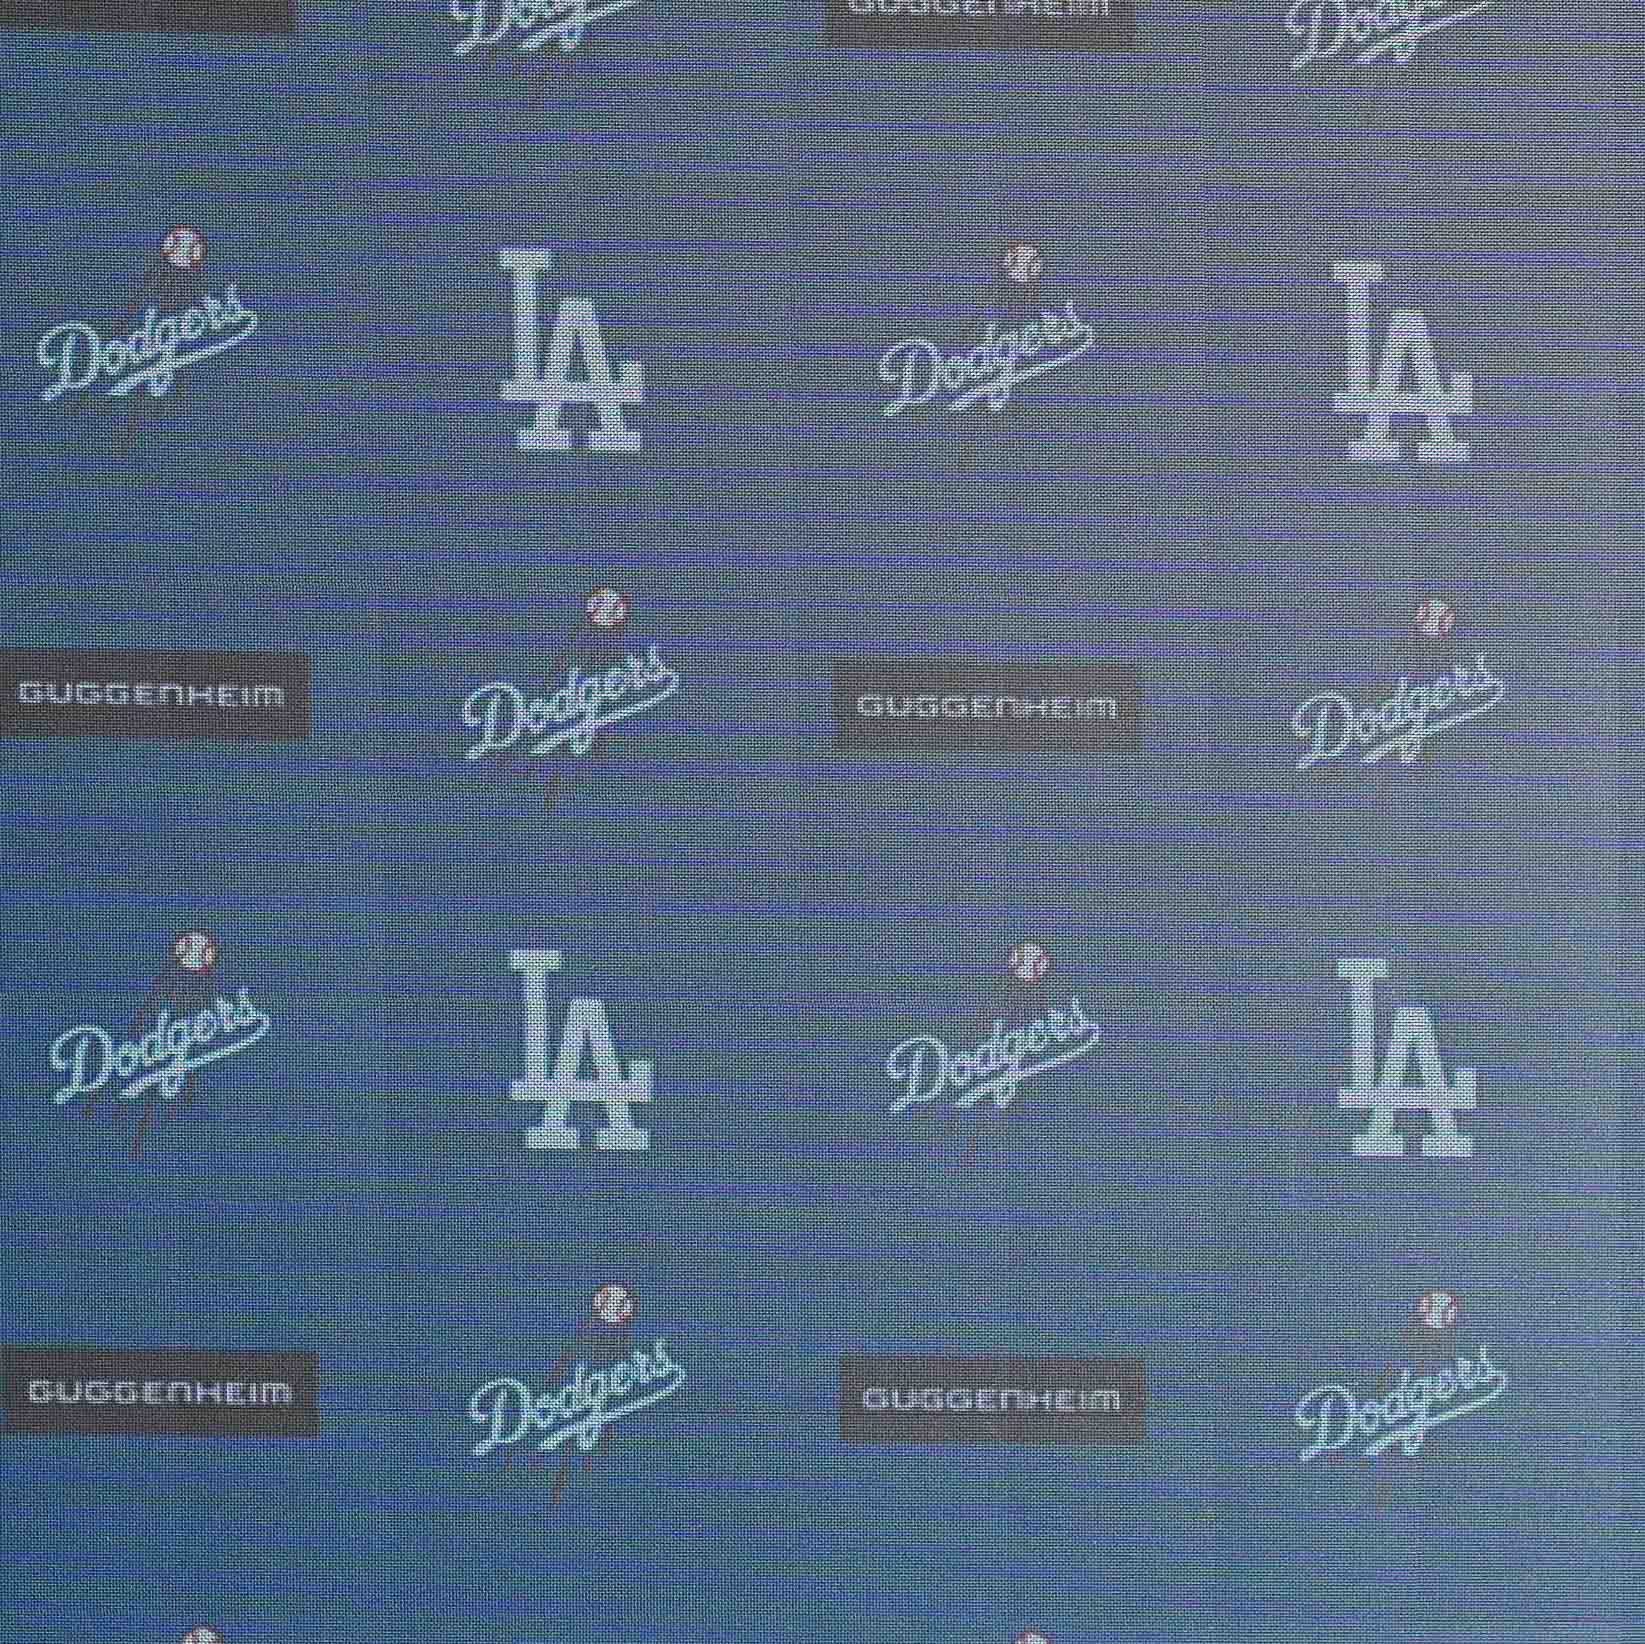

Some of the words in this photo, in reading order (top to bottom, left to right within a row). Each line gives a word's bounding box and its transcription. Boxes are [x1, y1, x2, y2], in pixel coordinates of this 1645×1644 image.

[36, 283, 258, 402] Dodgers
[499, 248, 644, 453] LA
[880, 301, 1094, 417] Dodgers
[1333, 261, 1472, 462] LA
[18, 680, 284, 707] GUGGENHEIM
[462, 646, 678, 760] Dodgers
[857, 694, 1117, 717] GUGGENHEIM
[1293, 653, 1505, 769] Dodgers
[50, 987, 271, 1105] Dodgers
[509, 948, 653, 1151] LA
[887, 998, 1099, 1113] Dodgers
[1338, 958, 1476, 1157] LA
[26, 1378, 293, 1406] GUGGENHEIM
[469, 1337, 685, 1456] Dodgers
[862, 1387, 1121, 1412] GUGGENHEIM
[1295, 1346, 1506, 1461] Dodgers
